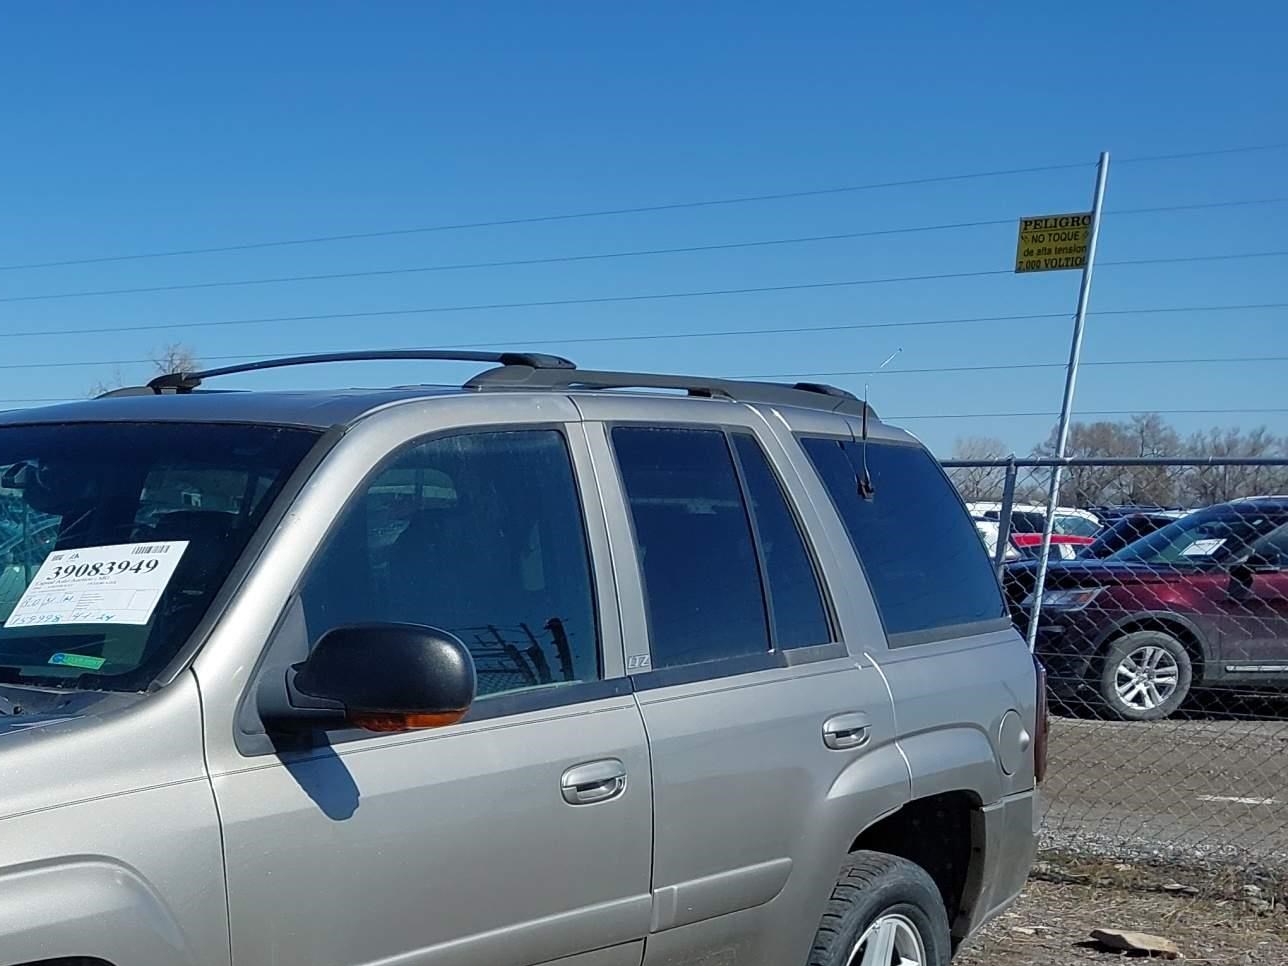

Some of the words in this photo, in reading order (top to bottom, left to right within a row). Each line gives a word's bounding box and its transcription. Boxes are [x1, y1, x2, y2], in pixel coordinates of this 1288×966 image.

[1023, 215, 1092, 231] PELIGRO
[1031, 233, 1045, 243] NO
[1048, 231, 1080, 242] TOQUE
[46, 559, 159, 580] 39083949
[628, 655, 649, 669] LTZ
